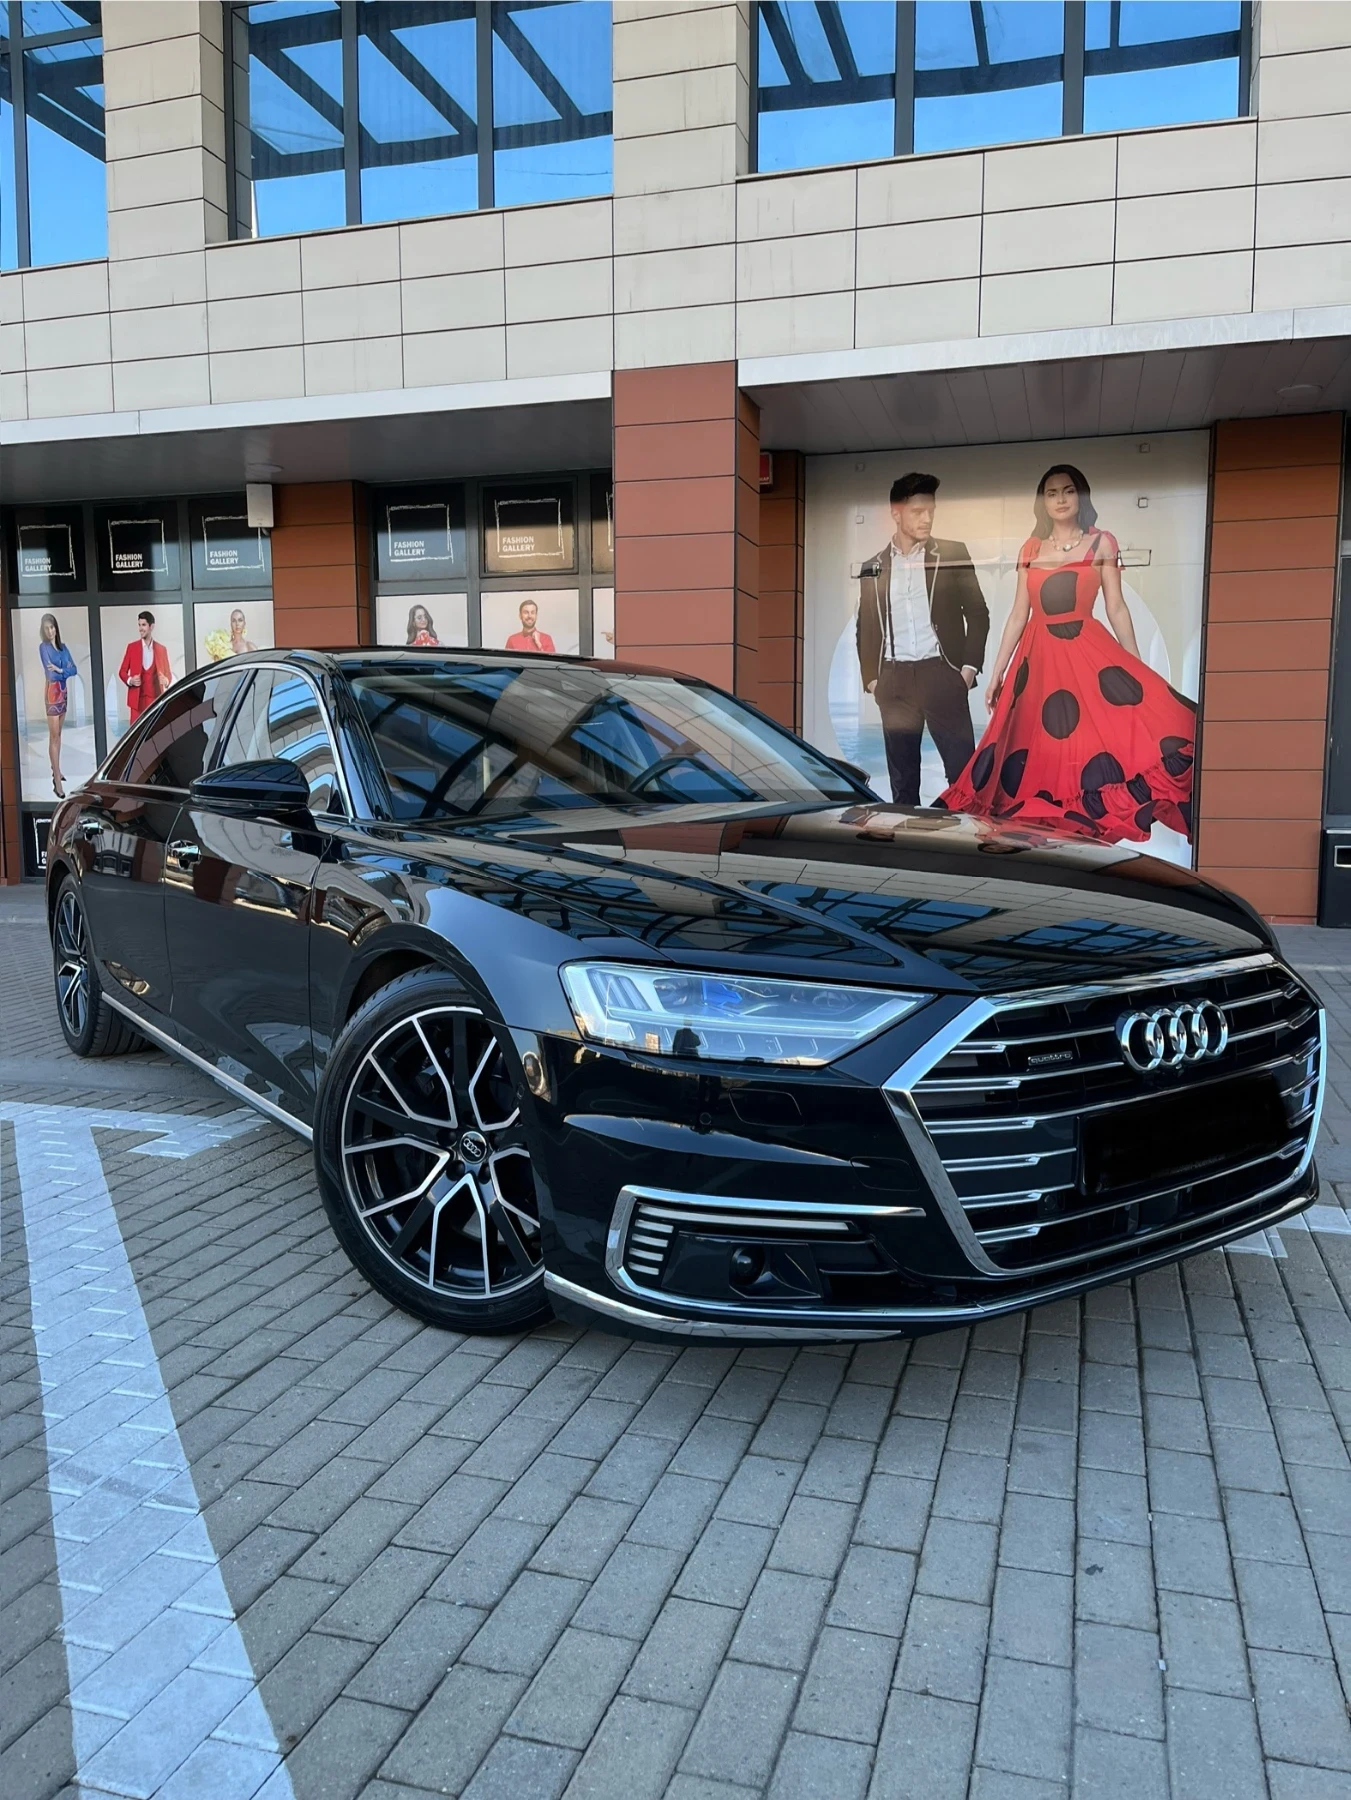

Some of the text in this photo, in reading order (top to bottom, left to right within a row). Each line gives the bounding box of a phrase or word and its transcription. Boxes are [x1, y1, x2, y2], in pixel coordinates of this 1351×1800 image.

[393, 540, 425, 549] FASHION
[502, 536, 535, 545] FASHION
[393, 549, 426, 557] GALLERY
[502, 544, 536, 553] GALLERY
[115, 553, 143, 561] FASHION
[209, 549, 238, 558] FASHION
[24, 557, 51, 565] FASHION
[115, 560, 144, 569] GALLERY
[209, 557, 239, 565] GALLERY
[24, 564, 52, 572] GALLERY
[1030, 1053, 1071, 1064] quattro
